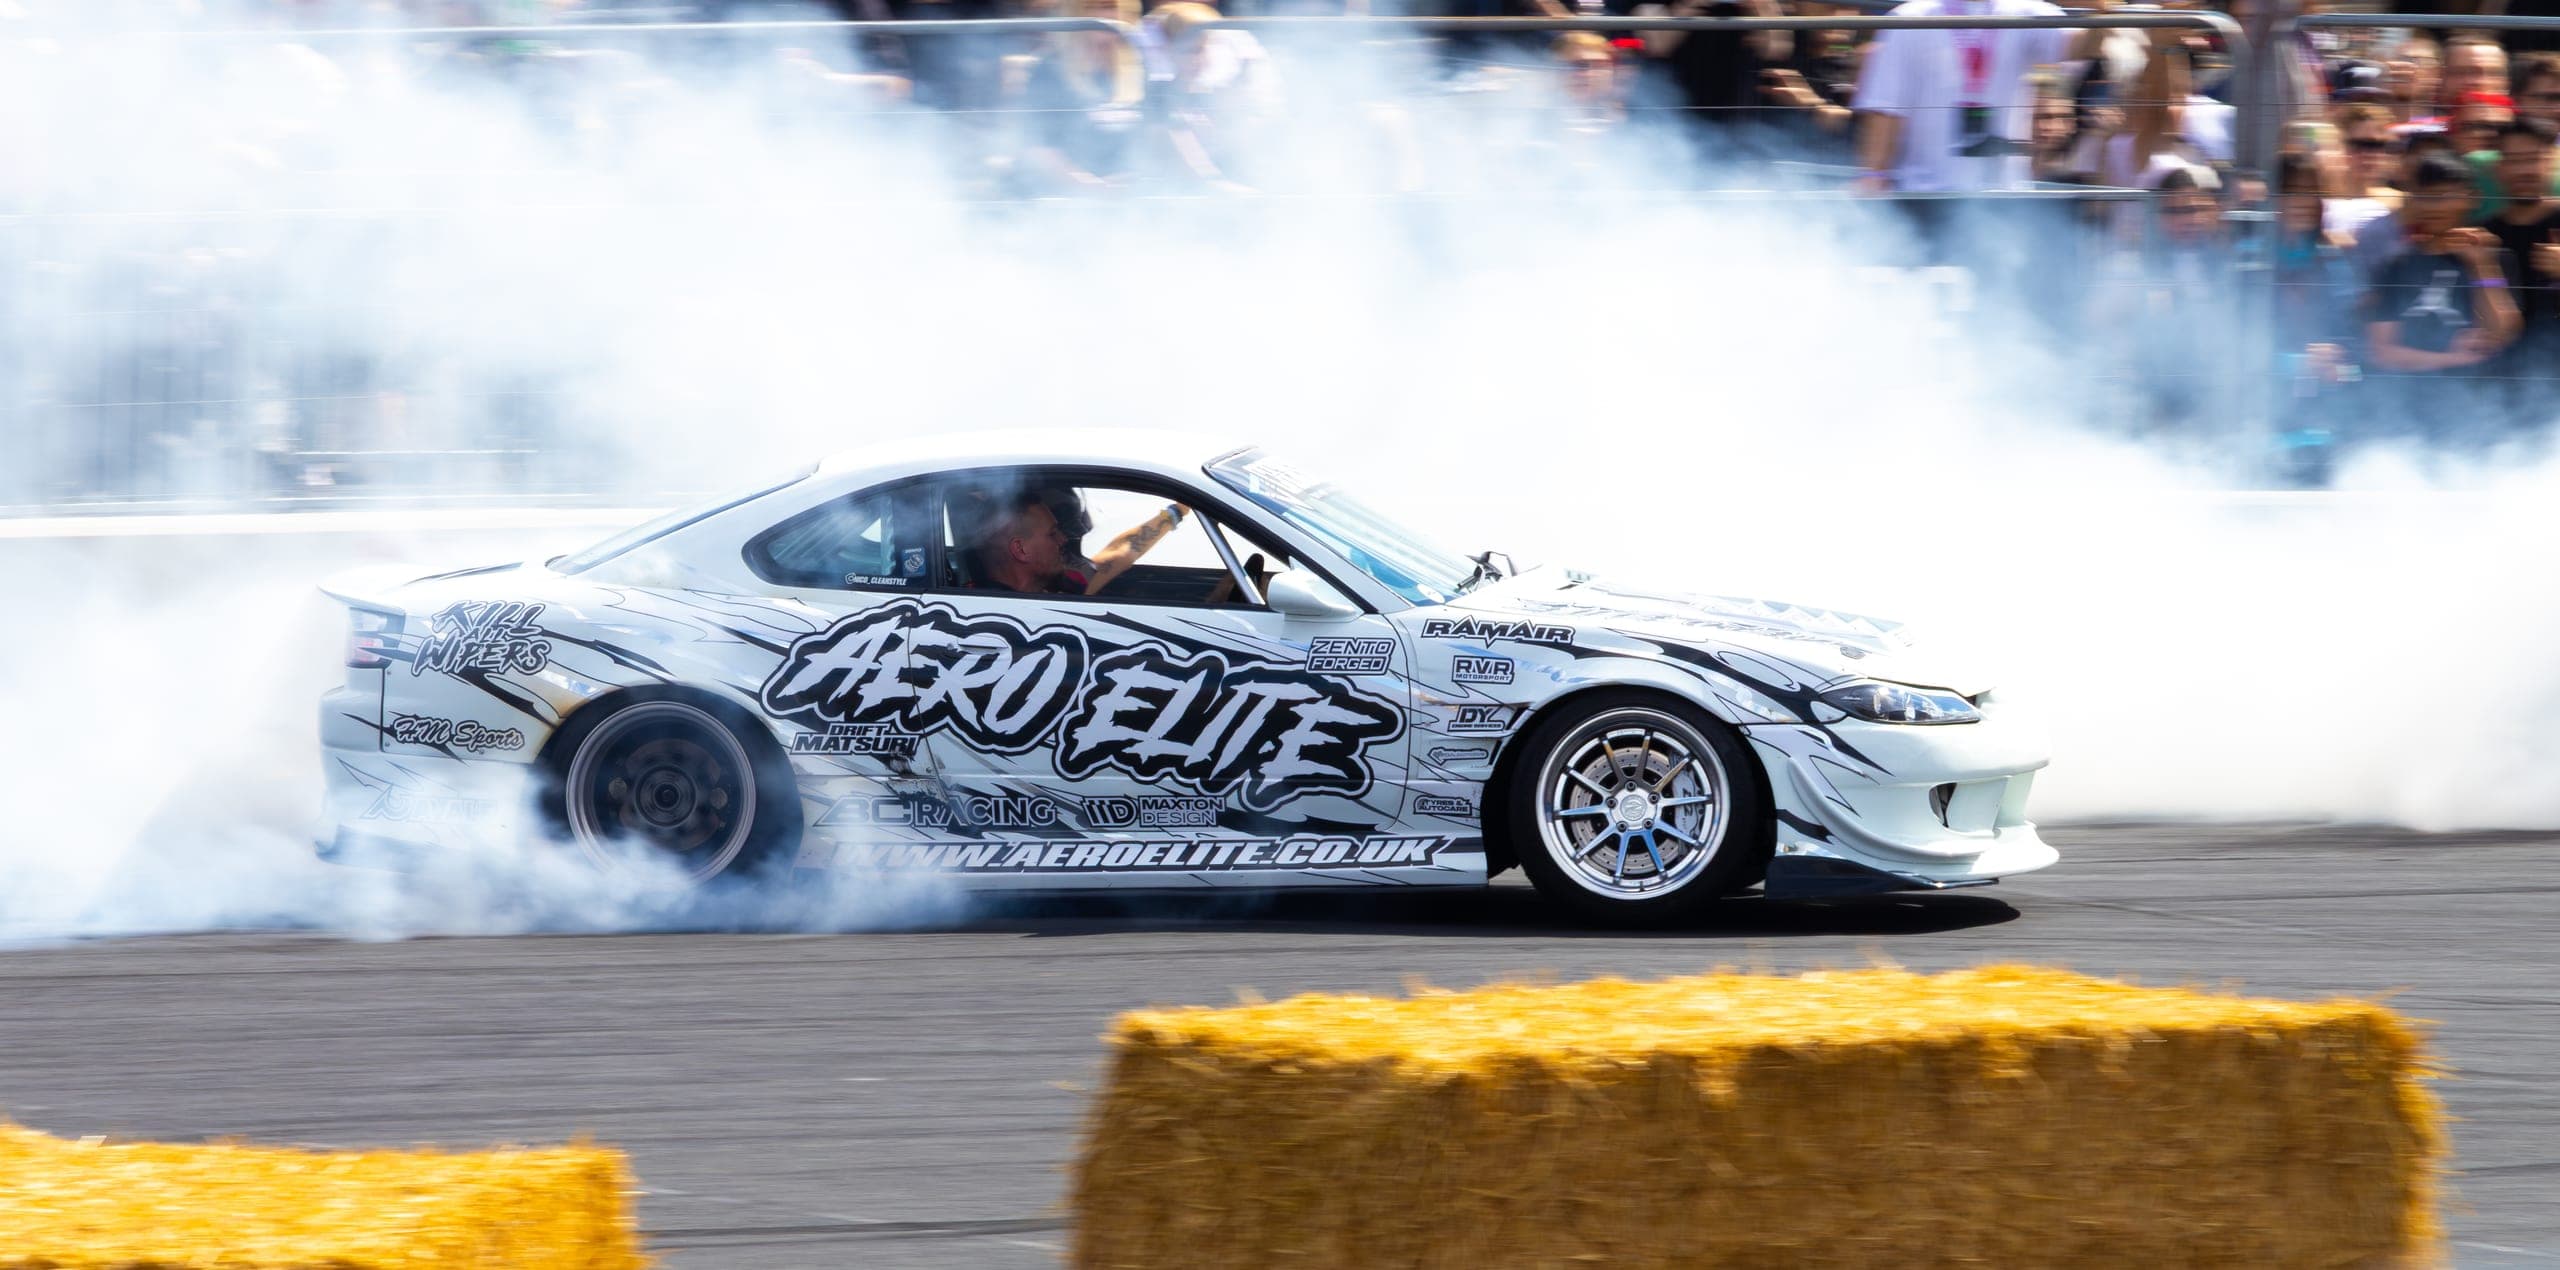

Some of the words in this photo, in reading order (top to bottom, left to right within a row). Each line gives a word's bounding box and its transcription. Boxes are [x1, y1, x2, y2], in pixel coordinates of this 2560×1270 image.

[432, 600, 545, 637] KILL
[1425, 616, 1573, 645] RAMAIR
[411, 629, 551, 676] WIPERS
[1311, 640, 1392, 655] ZENTO
[1311, 657, 1385, 670] FORGED
[774, 613, 1067, 735] AERO
[1455, 673, 1511, 681] MOTORSPORT
[1459, 707, 1494, 723] DY
[394, 717, 450, 744] HM
[454, 721, 524, 752] Sports
[829, 725, 888, 736] DRIFT
[1069, 661, 1383, 796] ELITE
[794, 736, 914, 755] MATSURI
[915, 796, 1056, 827] RACING
[1141, 798, 1225, 811] MAXTON
[1141, 811, 1216, 824] DESIGN
